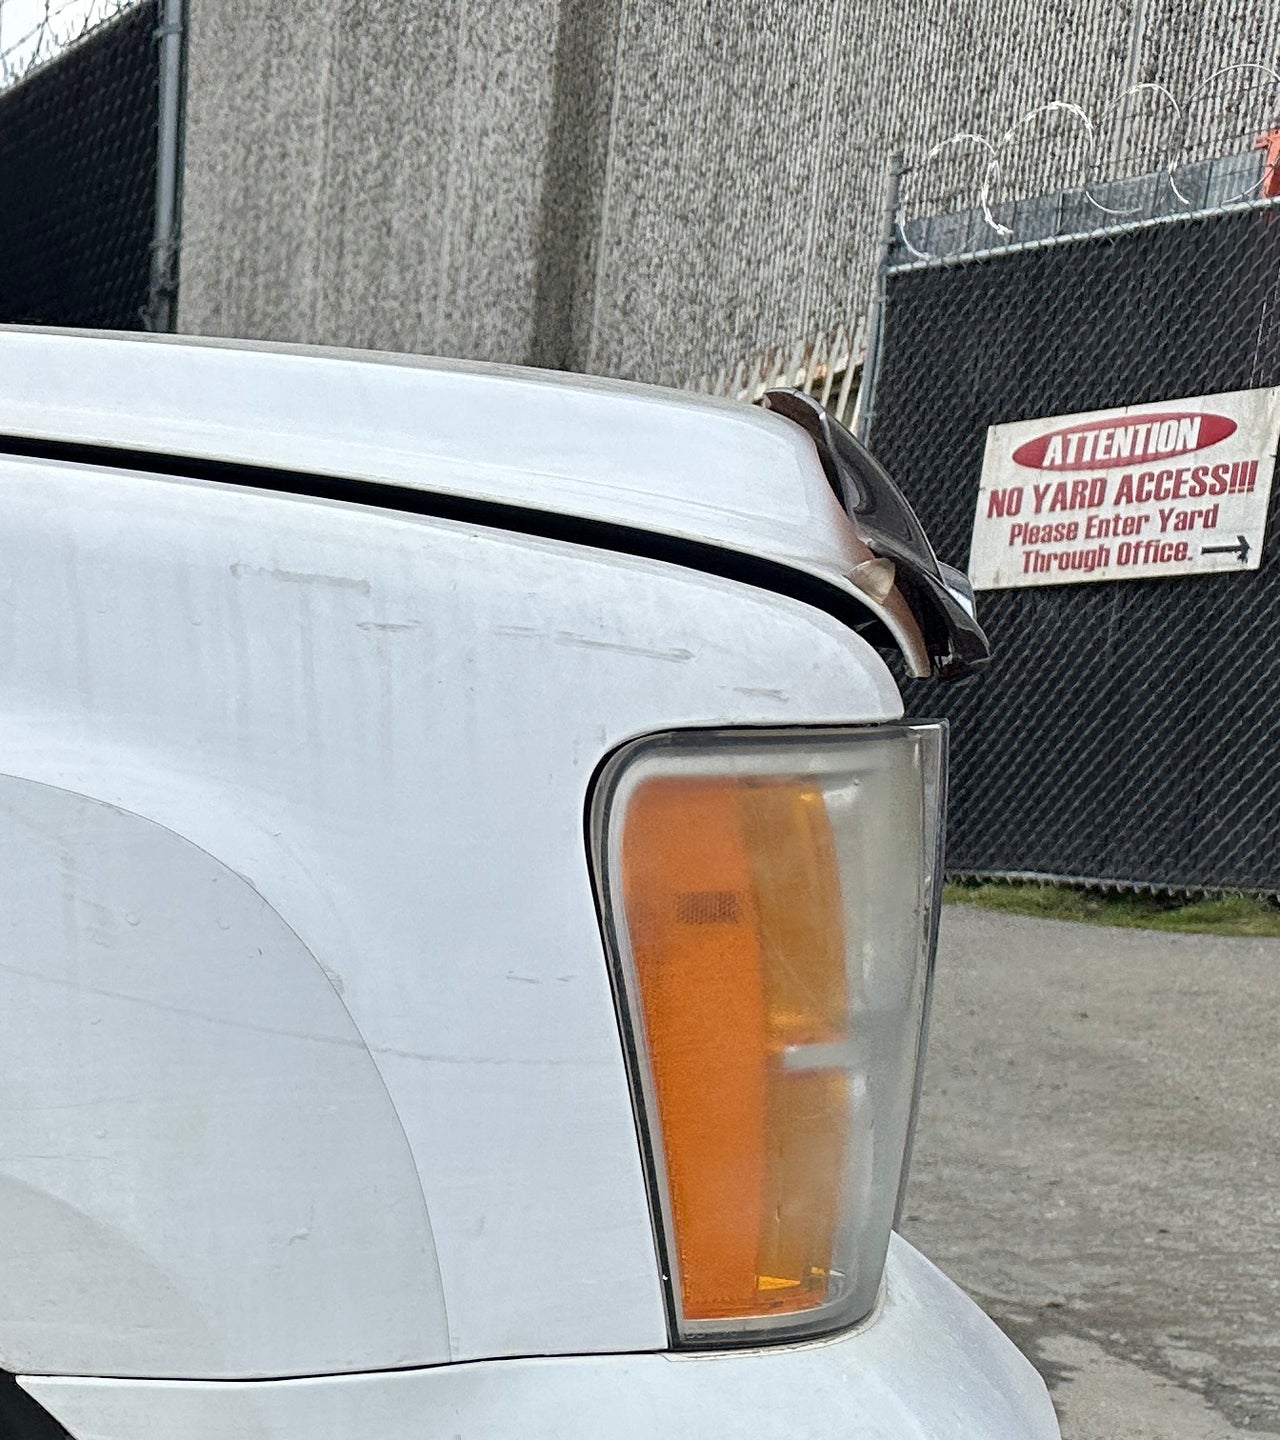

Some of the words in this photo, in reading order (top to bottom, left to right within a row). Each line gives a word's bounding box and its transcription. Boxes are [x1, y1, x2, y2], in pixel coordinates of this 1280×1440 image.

[1040, 416, 1203, 468] ATTENTION
[986, 486, 1024, 520] NO
[1032, 477, 1109, 515] YARD
[1113, 459, 1260, 507] ACCESS!!!
[1008, 519, 1079, 547] Please
[1085, 512, 1150, 540] Enter
[1157, 502, 1220, 533] Yard
[1022, 547, 1111, 574] Through
[1115, 538, 1194, 567] Office.
